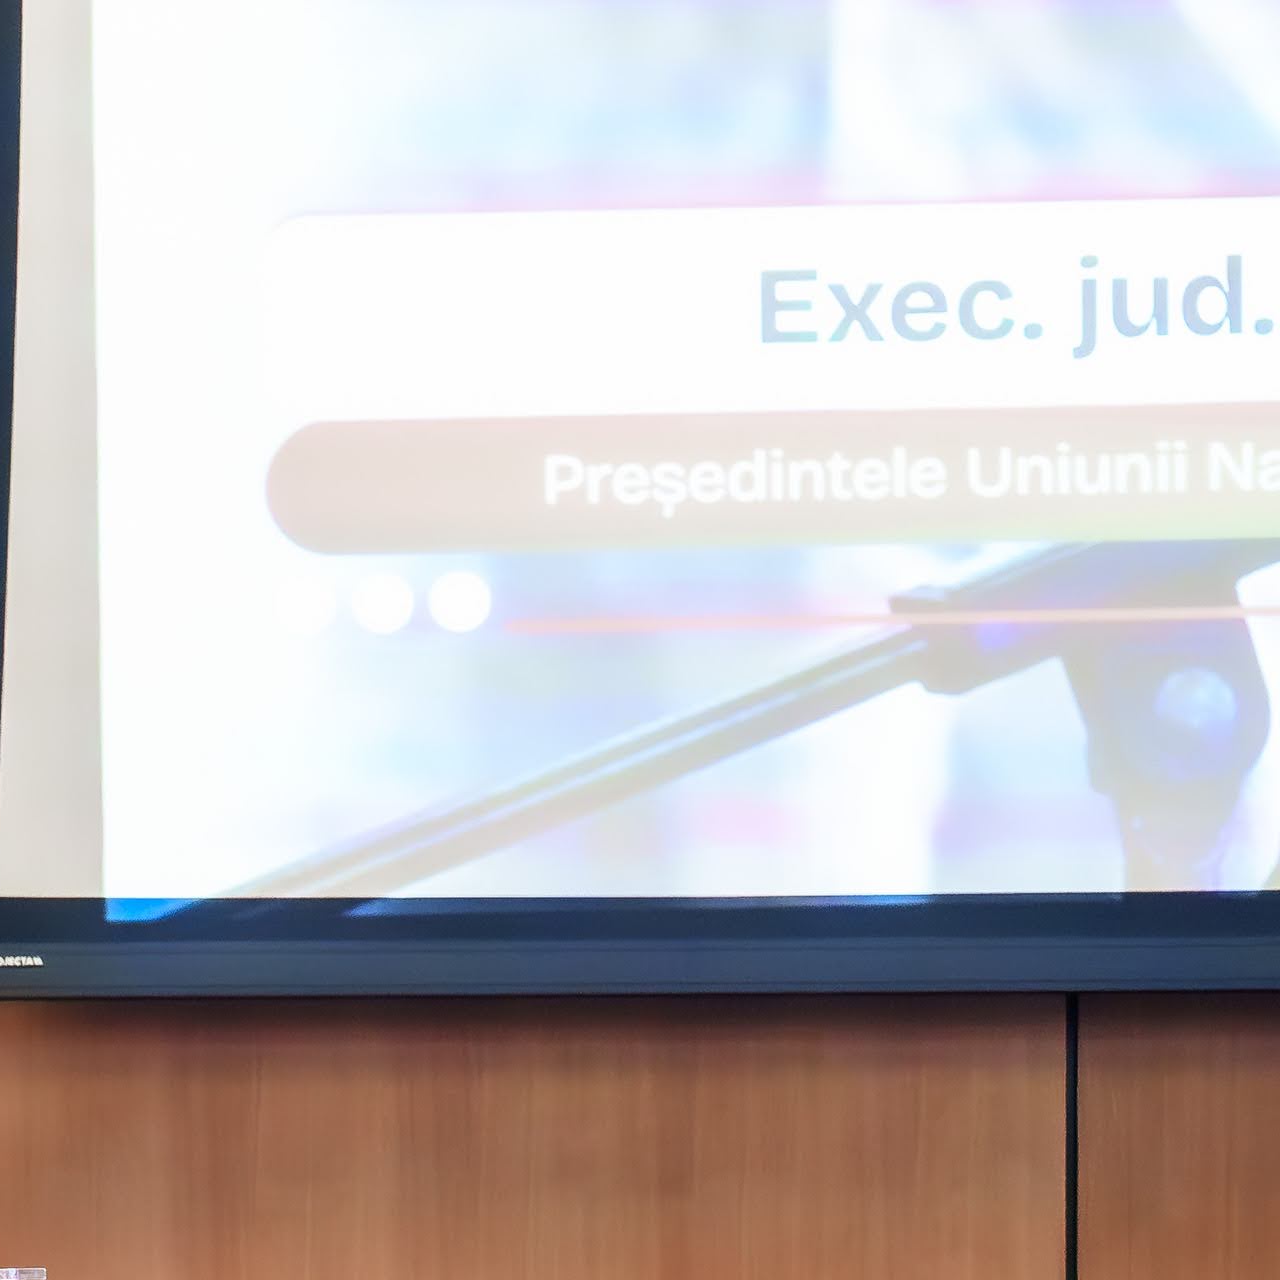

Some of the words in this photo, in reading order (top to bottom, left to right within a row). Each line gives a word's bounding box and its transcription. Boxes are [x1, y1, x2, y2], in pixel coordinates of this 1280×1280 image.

[761, 269, 1044, 344] Exec.
[1073, 254, 1274, 359] jud.
[544, 446, 948, 517] Președintele
[966, 440, 1188, 499] Uniunii
